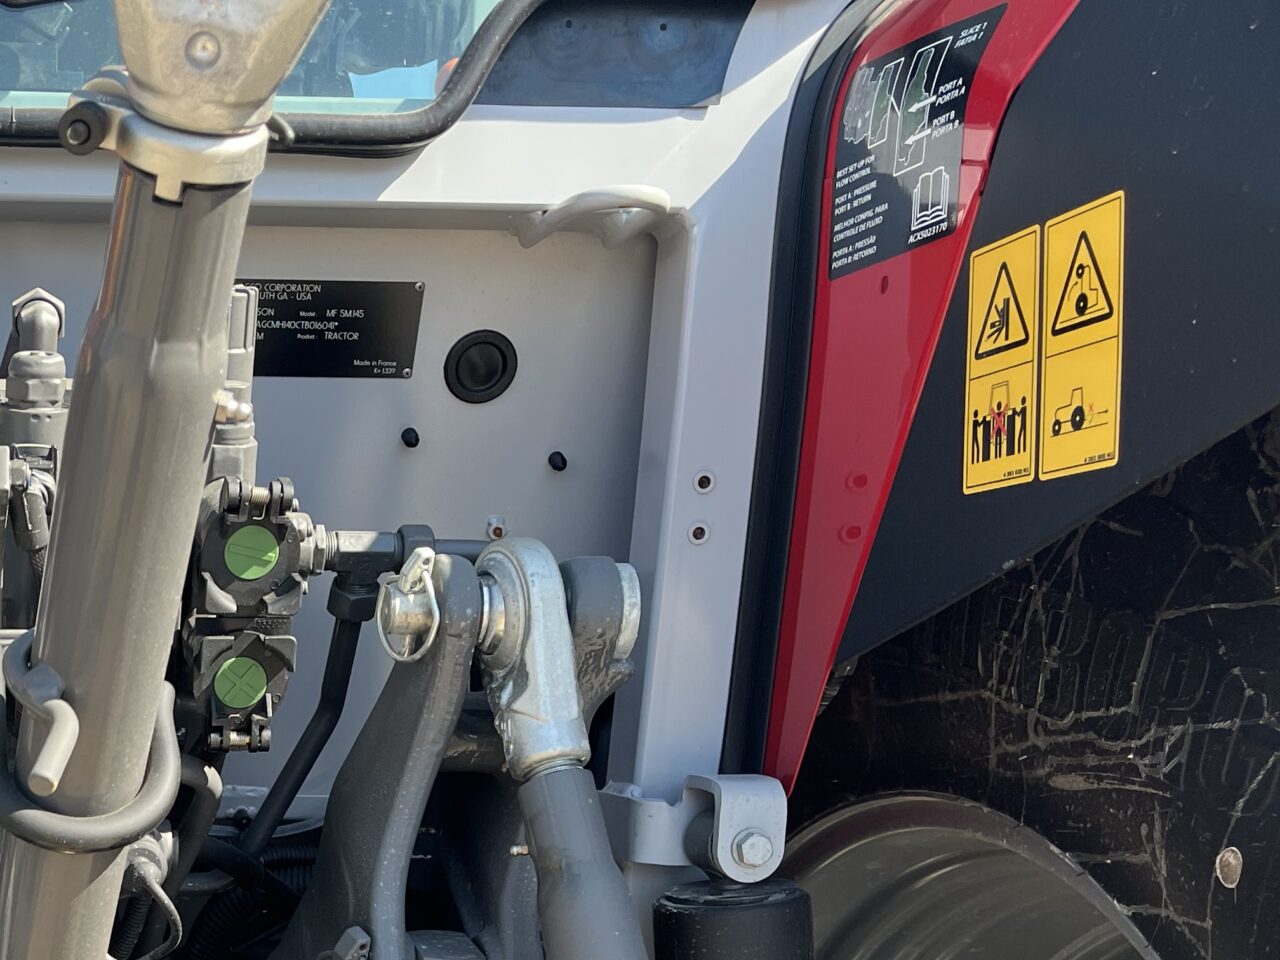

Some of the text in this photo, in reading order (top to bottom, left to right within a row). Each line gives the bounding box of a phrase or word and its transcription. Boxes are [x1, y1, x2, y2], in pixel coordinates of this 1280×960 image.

[959, 24, 982, 38] SLICE
[935, 86, 965, 106] PORTA A
[938, 77, 963, 95] PORT A
[932, 110, 955, 127] PORT B
[931, 119, 959, 139] PORTA B
[837, 167, 848, 178] BEST
[848, 163, 857, 173] SET
[865, 154, 875, 165] FOR
[836, 167, 870, 189] FLOW CONTROL
[835, 193, 847, 205] PORT
[853, 180, 877, 196] PRESSURE
[834, 204, 846, 216] PORT
[853, 193, 872, 207] RETURN
[834, 217, 855, 232] MELHOR
[874, 202, 888, 215] PARA
[833, 226, 859, 242] CONTROLE
[858, 222, 866, 232] DE
[832, 246, 848, 259] PORTA
[832, 257, 848, 270] PORTA
[852, 245, 877, 261] RETORNO
[264, 283, 322, 293] CORPORATION
[276, 292, 288, 300] GA
[296, 292, 312, 301] USA
[326, 309, 338, 318] MF
[324, 331, 360, 340] TRACTOR
